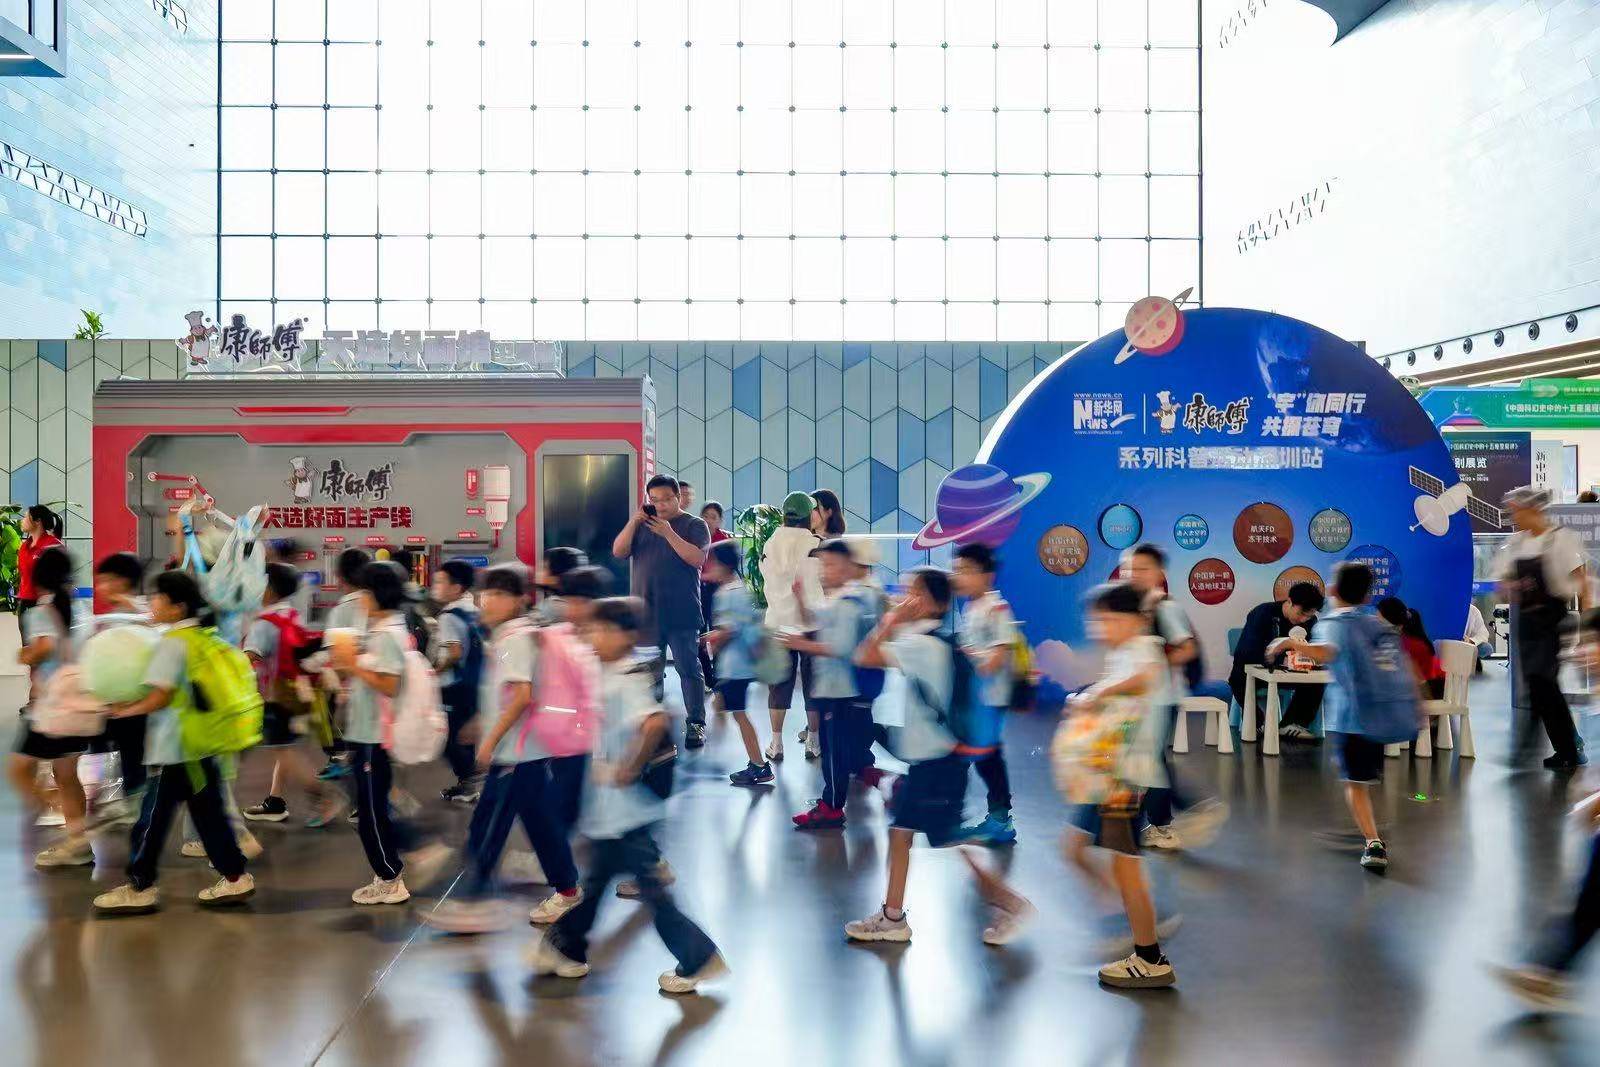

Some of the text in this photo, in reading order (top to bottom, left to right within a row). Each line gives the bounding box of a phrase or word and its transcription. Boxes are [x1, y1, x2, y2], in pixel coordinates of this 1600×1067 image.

[1093, 401, 1123, 417] 新华网
[1504, 403, 1600, 413] 《中国科幻史中的十五座里程
[1452, 456, 1488, 469] 别展览
[1250, 525, 1275, 533] 航天FD
[1247, 535, 1278, 543] 冻干技术
